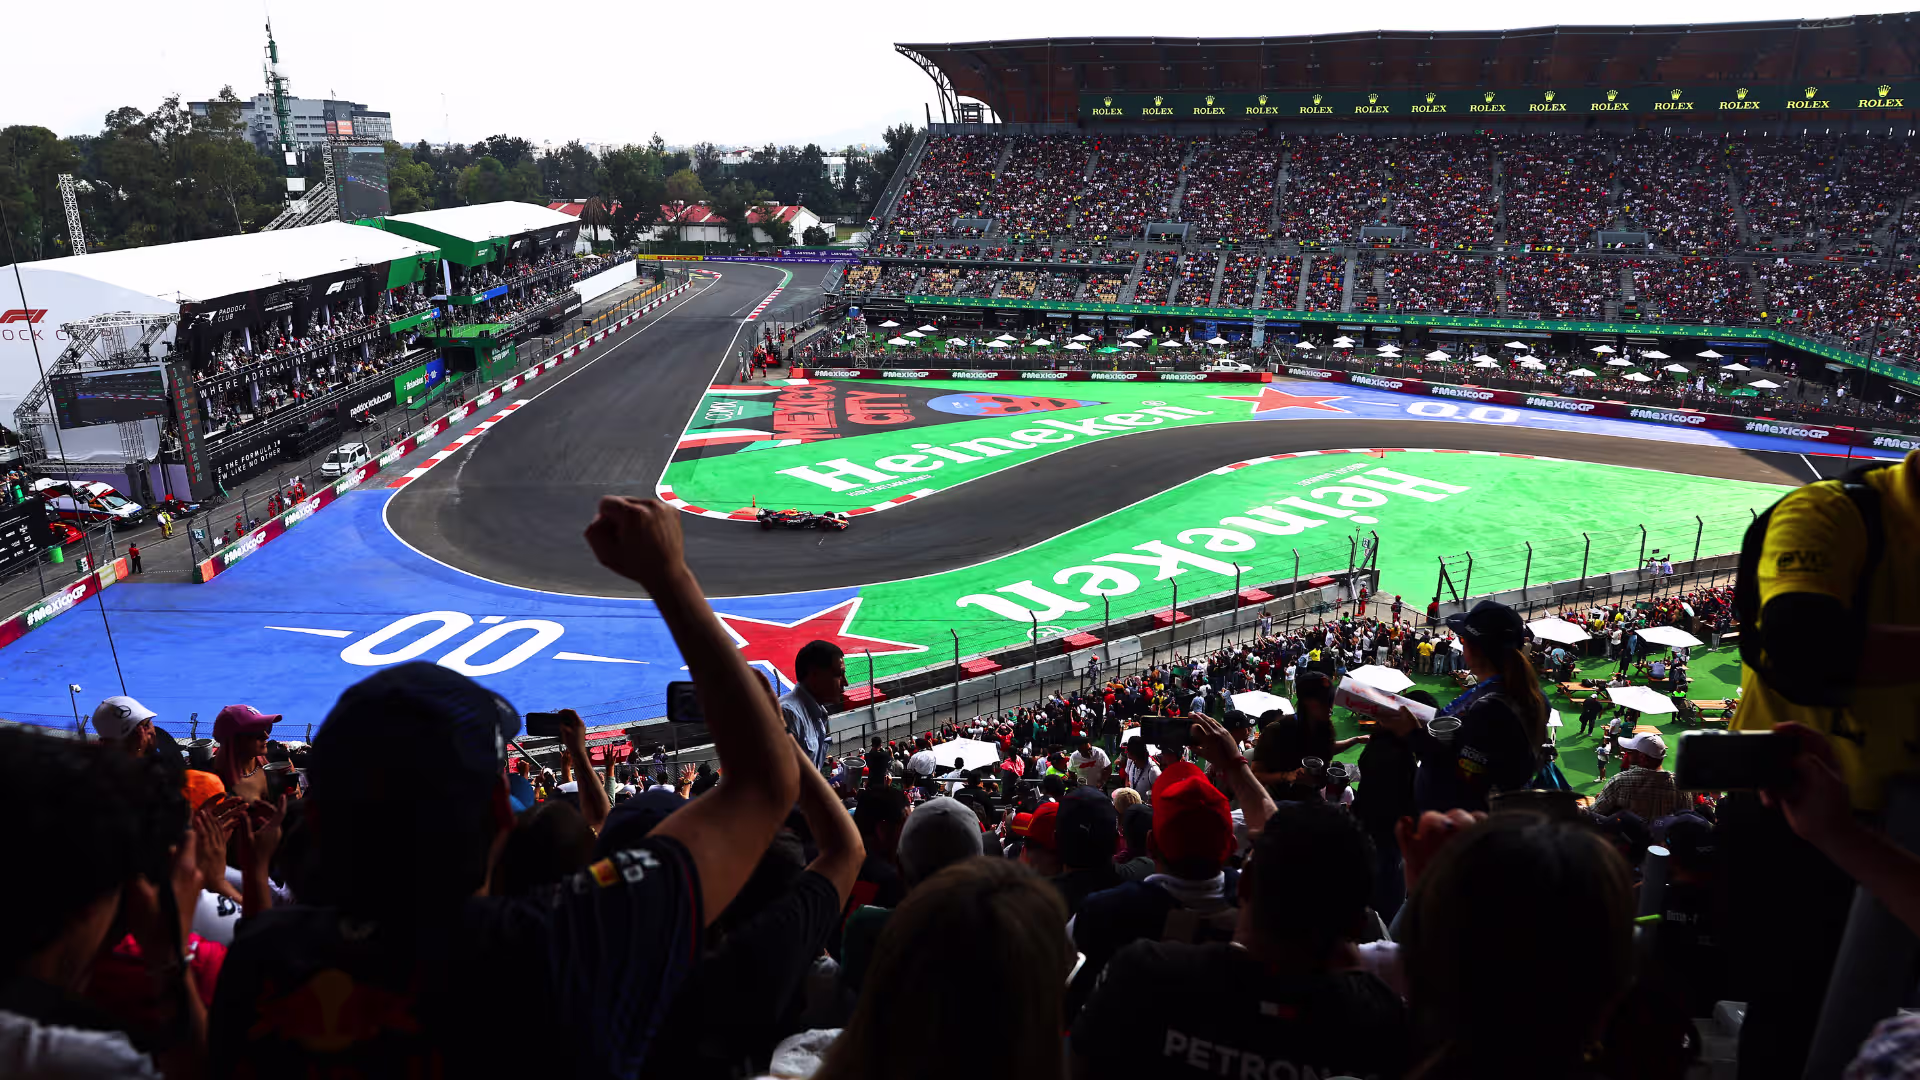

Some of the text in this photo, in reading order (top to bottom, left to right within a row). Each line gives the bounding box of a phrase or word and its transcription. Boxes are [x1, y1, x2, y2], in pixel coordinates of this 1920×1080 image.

[1299, 106, 1333, 114] ROLEX
[1354, 105, 1389, 114] ROLEX
[1411, 105, 1447, 113] ROLEX
[1469, 104, 1506, 112] ROLEX
[1529, 103, 1567, 112] ROLEX
[1591, 102, 1629, 111] ROLEX
[1654, 102, 1694, 110] ROLEX
[1719, 101, 1760, 110] ROLEX
[1786, 100, 1830, 109] ROLEX
[1857, 98, 1904, 108] ROLEX
[1193, 107, 1226, 115] ROLEX
[1246, 106, 1279, 115] ROLEX
[218, 303, 246, 315] PADDOCK
[217, 313, 234, 322] CLUB
[200, 329, 381, 398] WHERE ADRENALINE MEETS ELEGANCE
[814, 370, 860, 378] #MexicoGP
[883, 371, 928, 379] #MexicoGP
[1021, 372, 1068, 380] #MexicoGP
[1160, 373, 1207, 381] #MexicoGP
[1288, 368, 1332, 379] #MexicoGP
[1351, 374, 1403, 390] #MexicoGP
[1431, 386, 1494, 400] #MexicoGP
[350, 391, 392, 418] paddockclub.com
[704, 401, 738, 421] CDMX
[845, 390, 916, 425] CITY
[1526, 396, 1595, 412] #MexicoGP
[772, 384, 841, 441] MEXICO
[1406, 401, 1521, 423] 0.0
[1630, 408, 1706, 425] #MexicoGP
[1745, 422, 1829, 440] #MexicoGP
[775, 405, 1214, 492] Heineken
[225, 460, 239, 471] THE
[241, 446, 272, 463] FORMULA
[231, 467, 247, 478] LIKE
[260, 448, 281, 462] OTHER
[336, 469, 367, 495] #MexicoGP
[284, 497, 321, 527] #MexicoGP
[223, 530, 267, 565] #MexicoGP
[956, 467, 1471, 622] Heineken
[27, 583, 87, 627] #MexicoGP
[340, 610, 566, 677] 0.0
